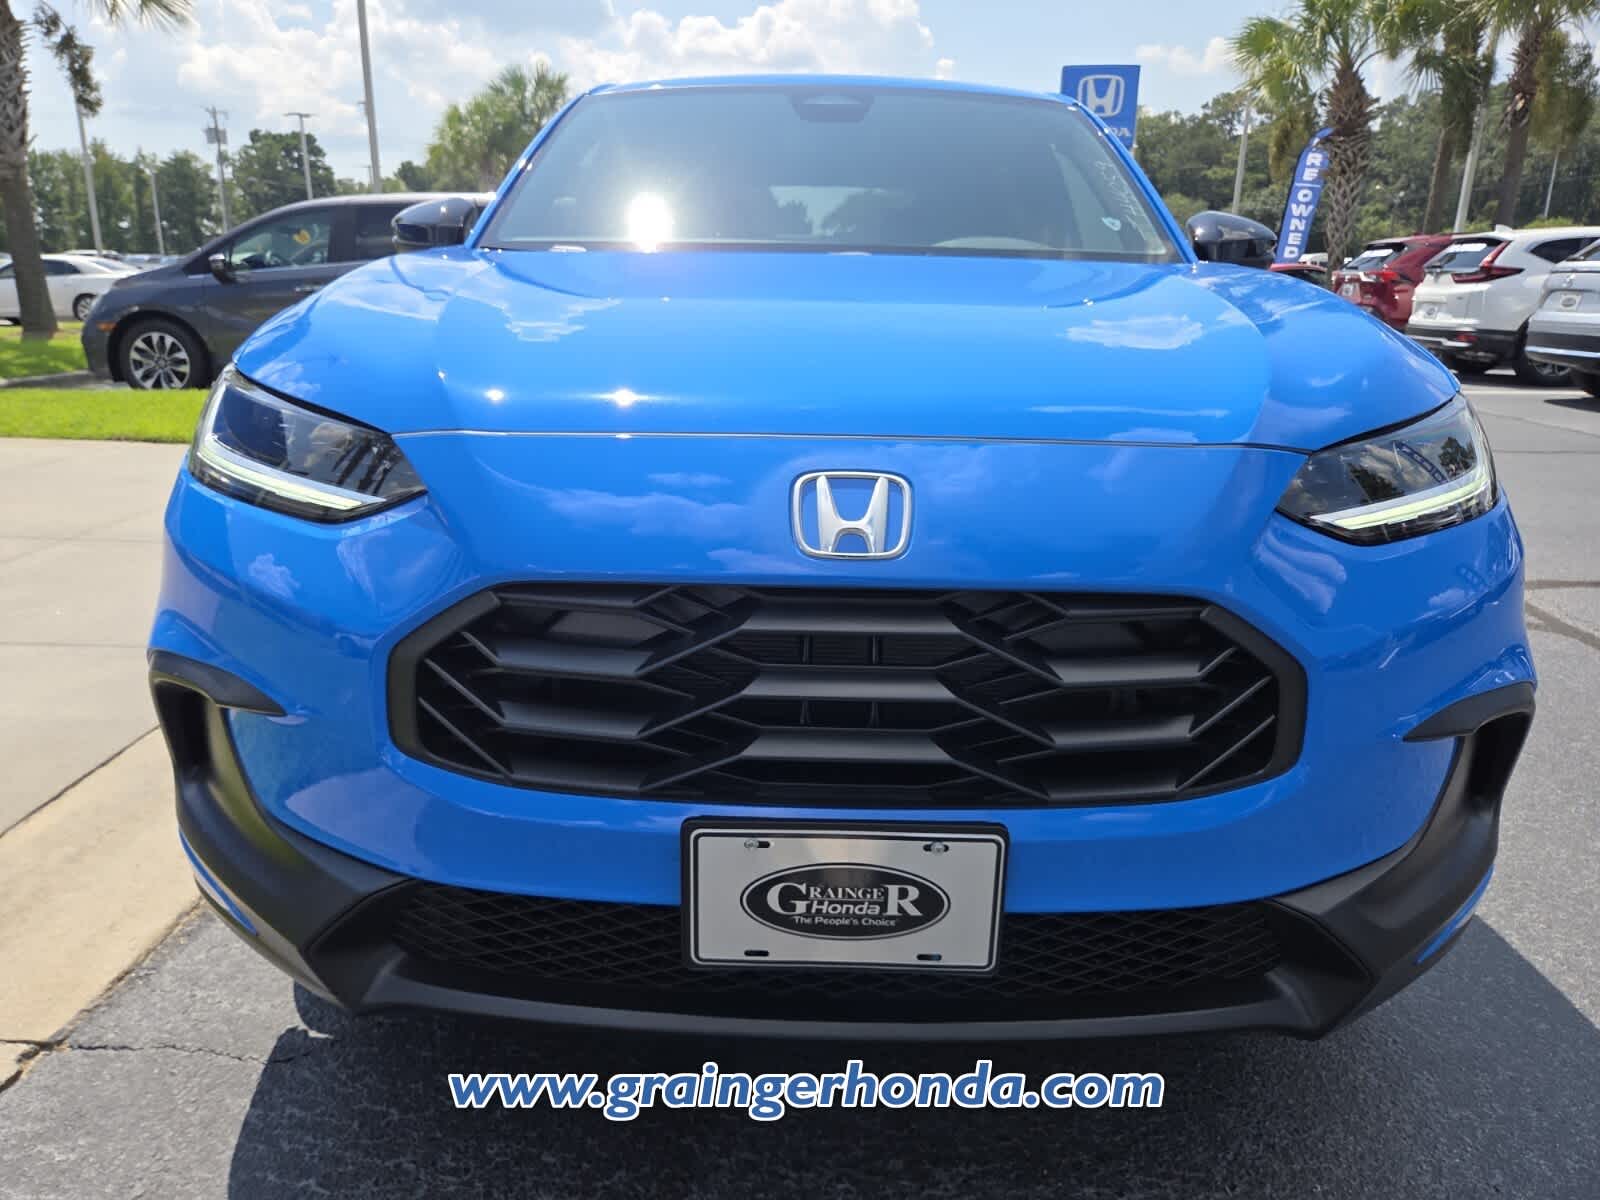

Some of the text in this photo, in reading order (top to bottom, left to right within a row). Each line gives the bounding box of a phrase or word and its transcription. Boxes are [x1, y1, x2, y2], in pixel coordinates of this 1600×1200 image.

[1283, 189, 1314, 259] OWNED
[766, 882, 923, 916] GRAINGER
[811, 901, 881, 915] Honda
[793, 916, 897, 927] The People's Choice
